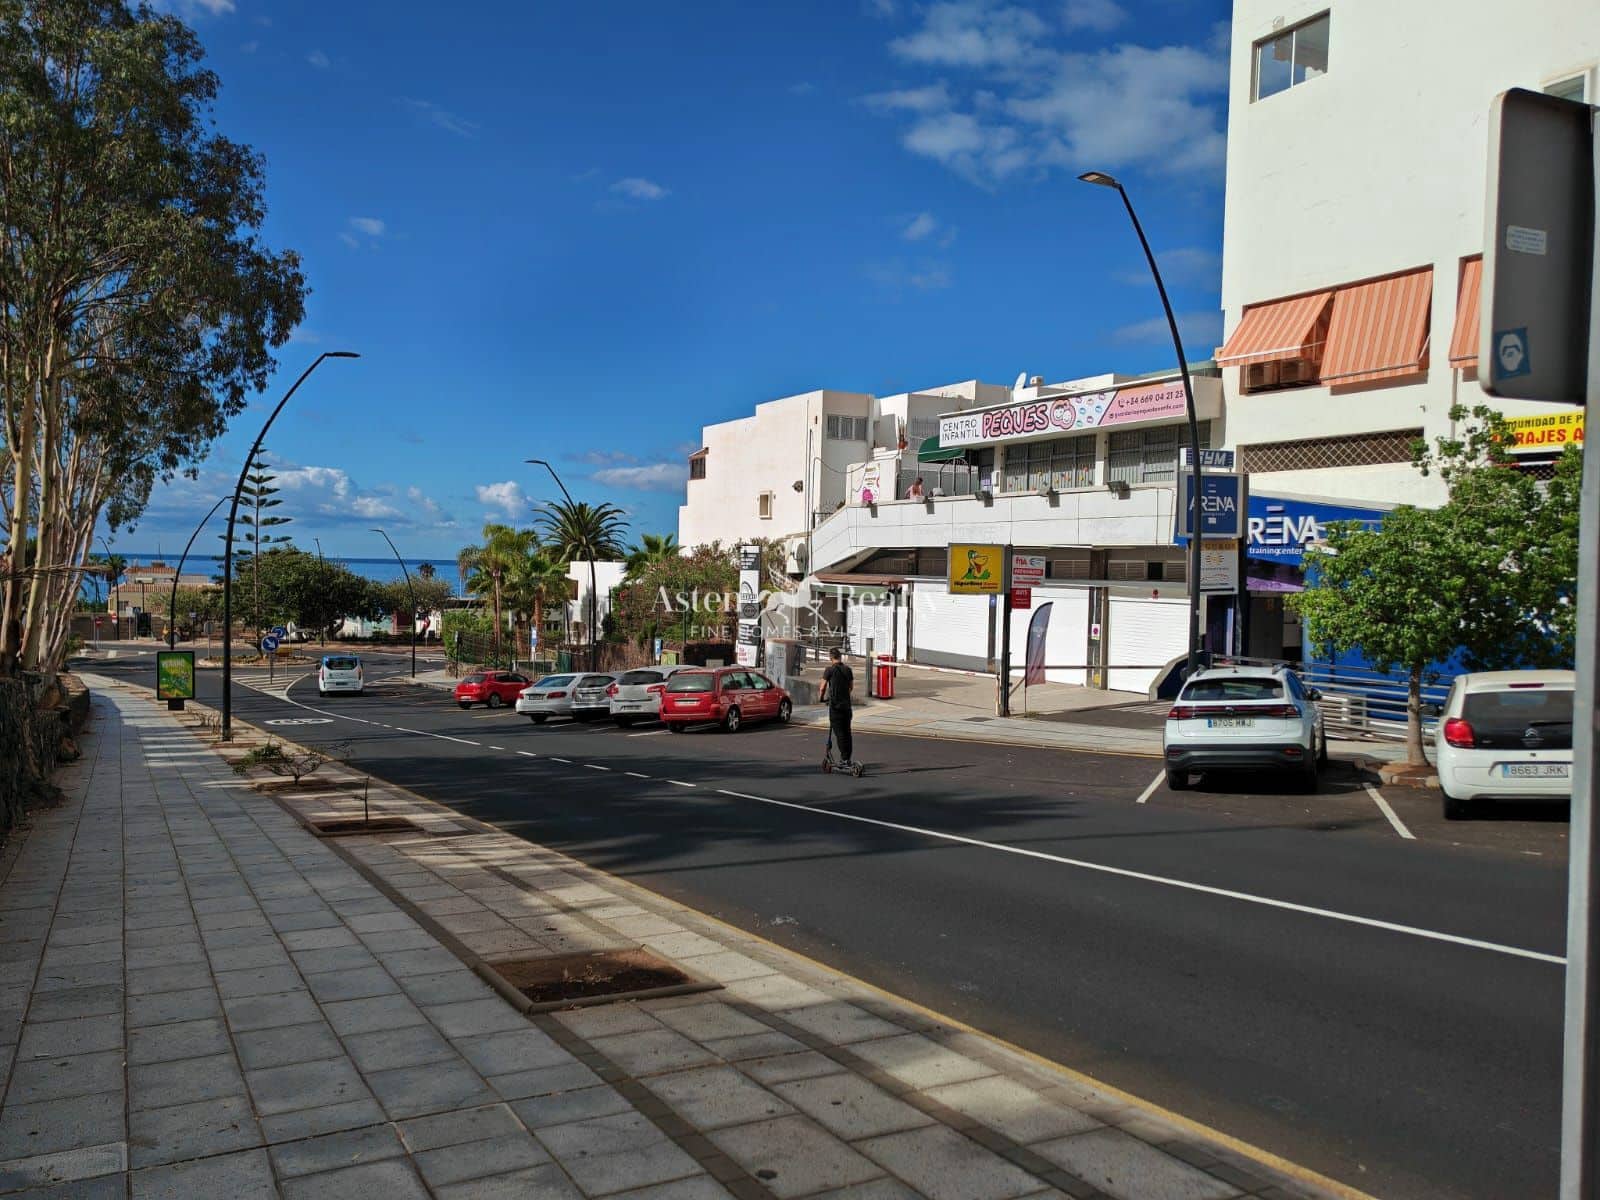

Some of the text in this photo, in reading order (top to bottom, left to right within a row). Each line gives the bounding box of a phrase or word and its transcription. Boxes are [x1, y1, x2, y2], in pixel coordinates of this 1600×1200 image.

[1140, 394, 1153, 405] 669
[1155, 392, 1164, 402] 04
[1166, 390, 1173, 400] 21
[942, 418, 977, 432] CENTRO
[981, 403, 1050, 439] PEQUES
[1558, 415, 1572, 425] DE
[942, 429, 980, 441] INFANTIL
[1247, 515, 1318, 545] RENA
